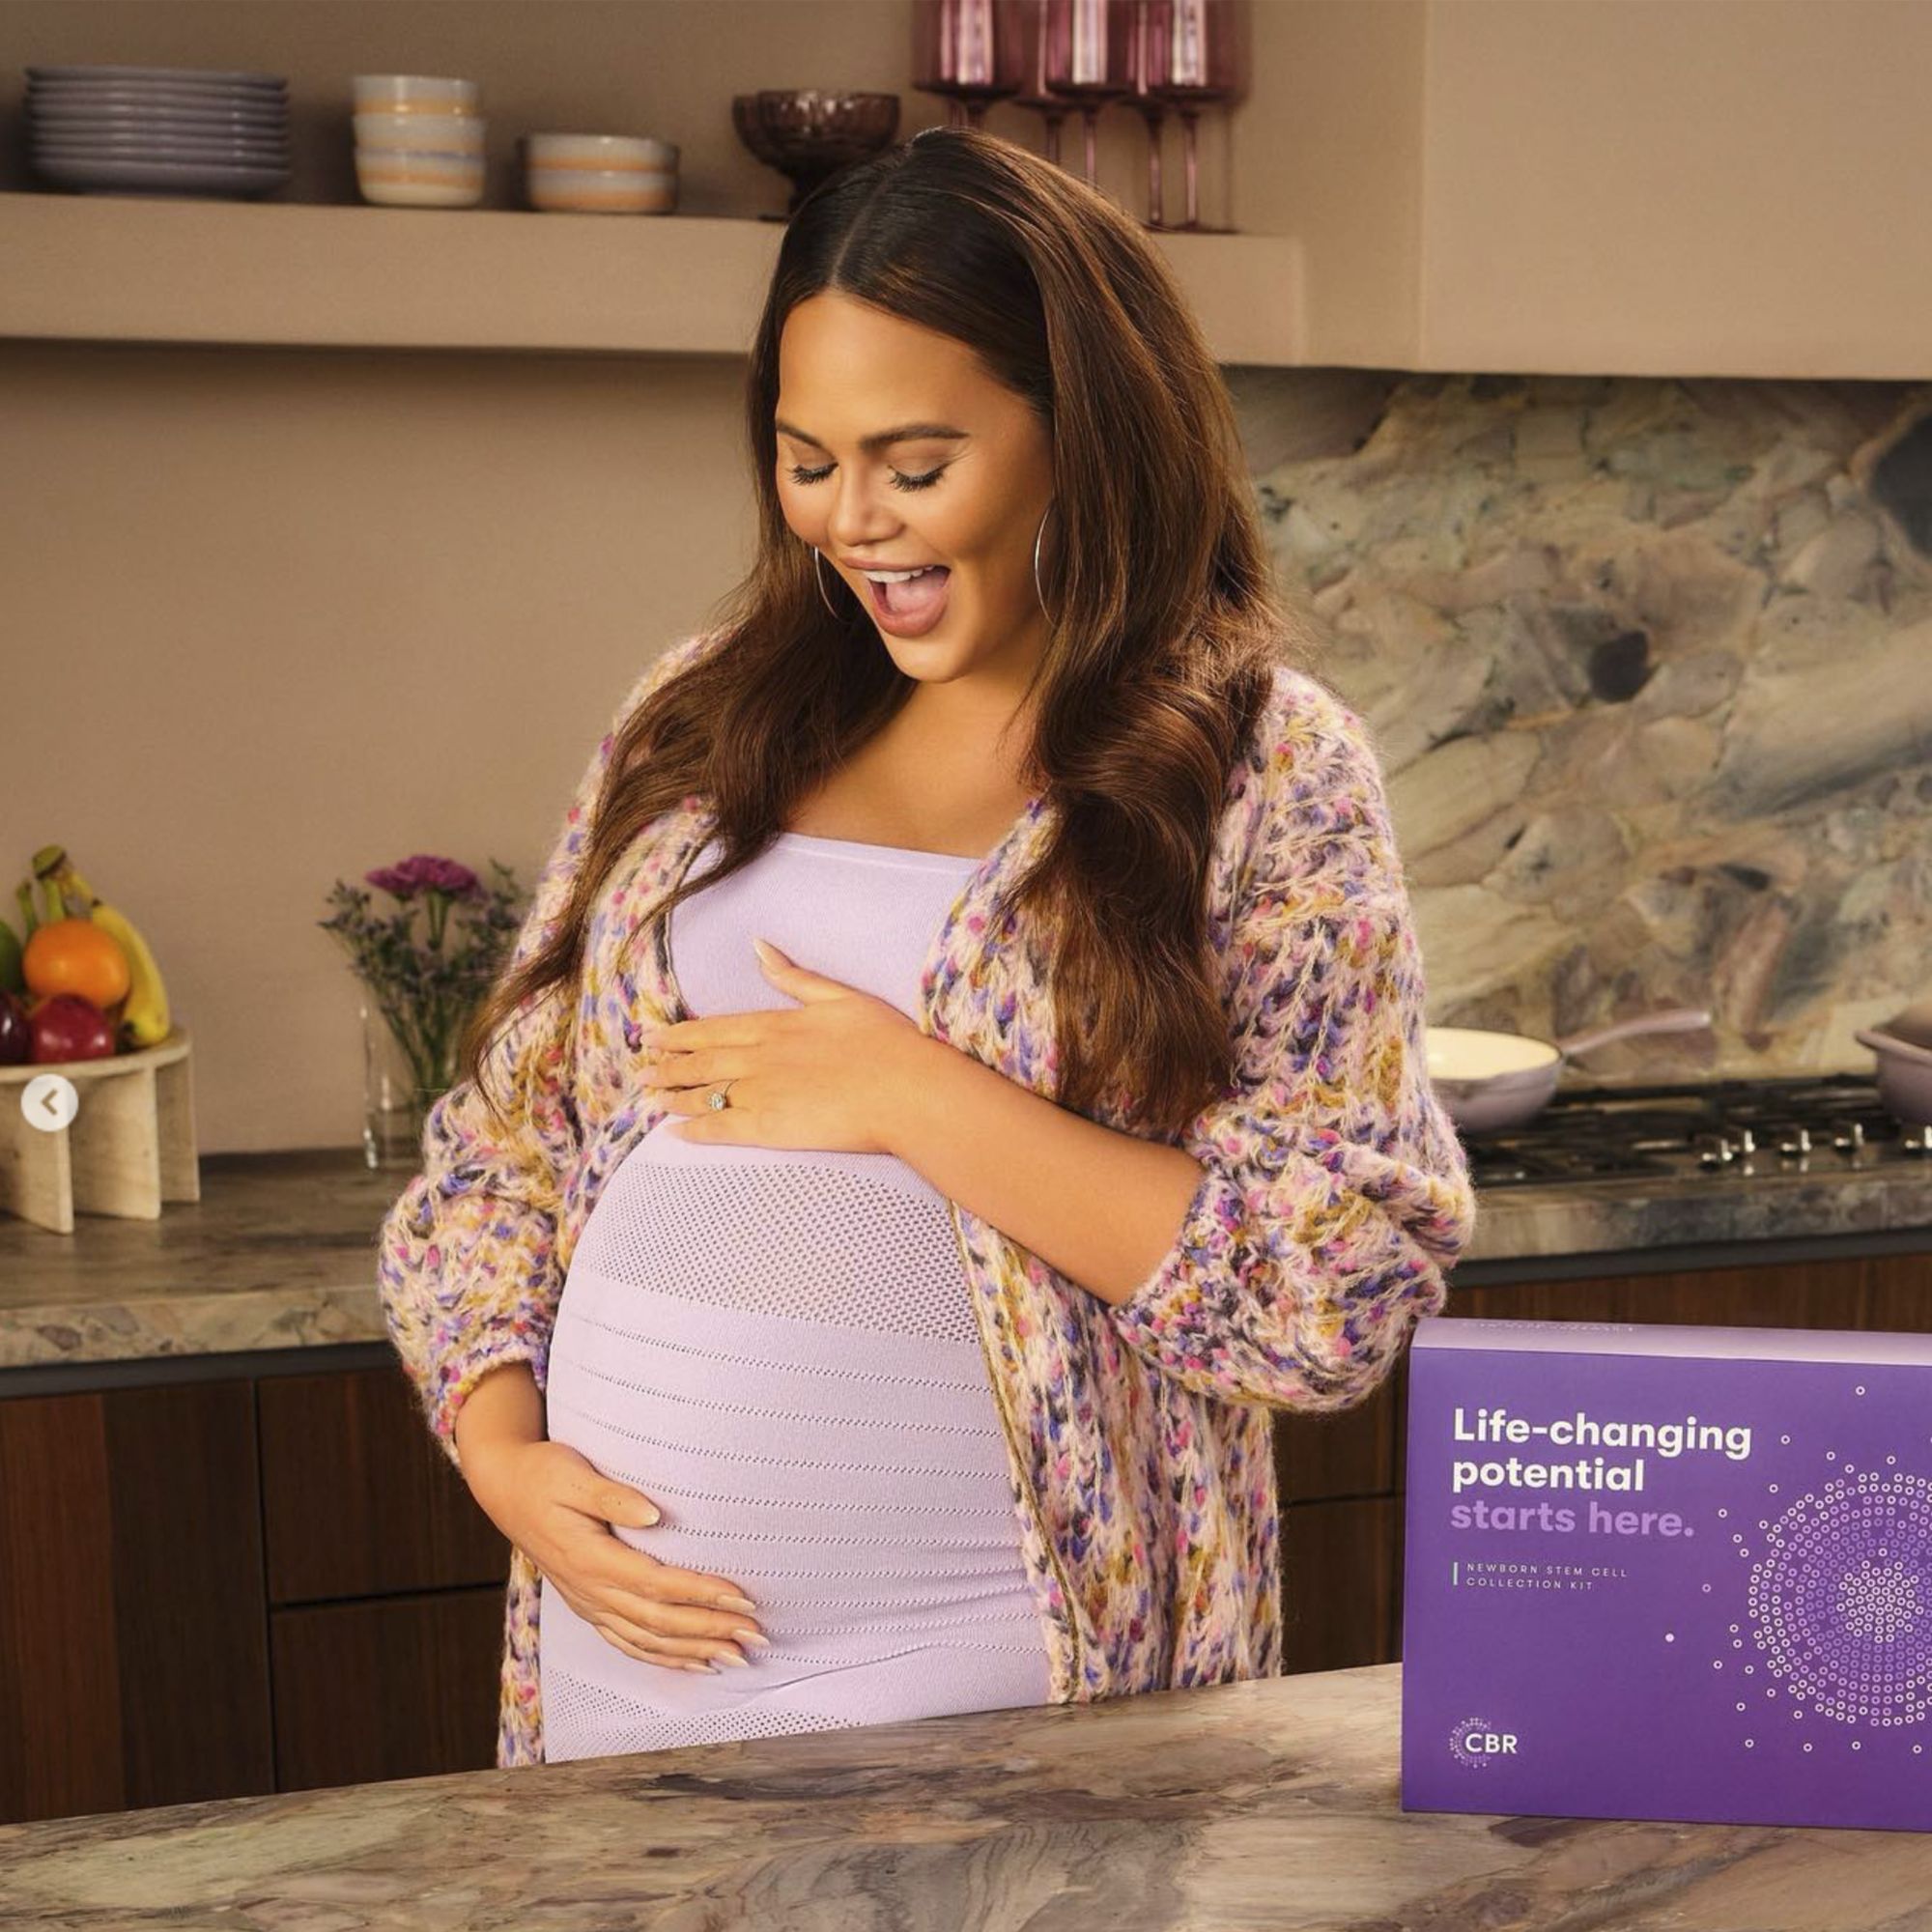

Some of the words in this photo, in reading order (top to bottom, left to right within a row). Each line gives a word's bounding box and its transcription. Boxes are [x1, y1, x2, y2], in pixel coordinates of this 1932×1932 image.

[1454, 1407, 1751, 1461] Life-changing
[1452, 1457, 1644, 1493] potential
[1450, 1499, 1576, 1533] starts
[1588, 1501, 1695, 1538] here.
[1466, 1563, 1538, 1575] NEWBORN
[1546, 1566, 1583, 1577] STEM
[1591, 1567, 1628, 1577] CELL
[1466, 1577, 1561, 1590] COLLECTION
[1570, 1580, 1594, 1591] KIT
[1465, 1733, 1518, 1755] CBR
